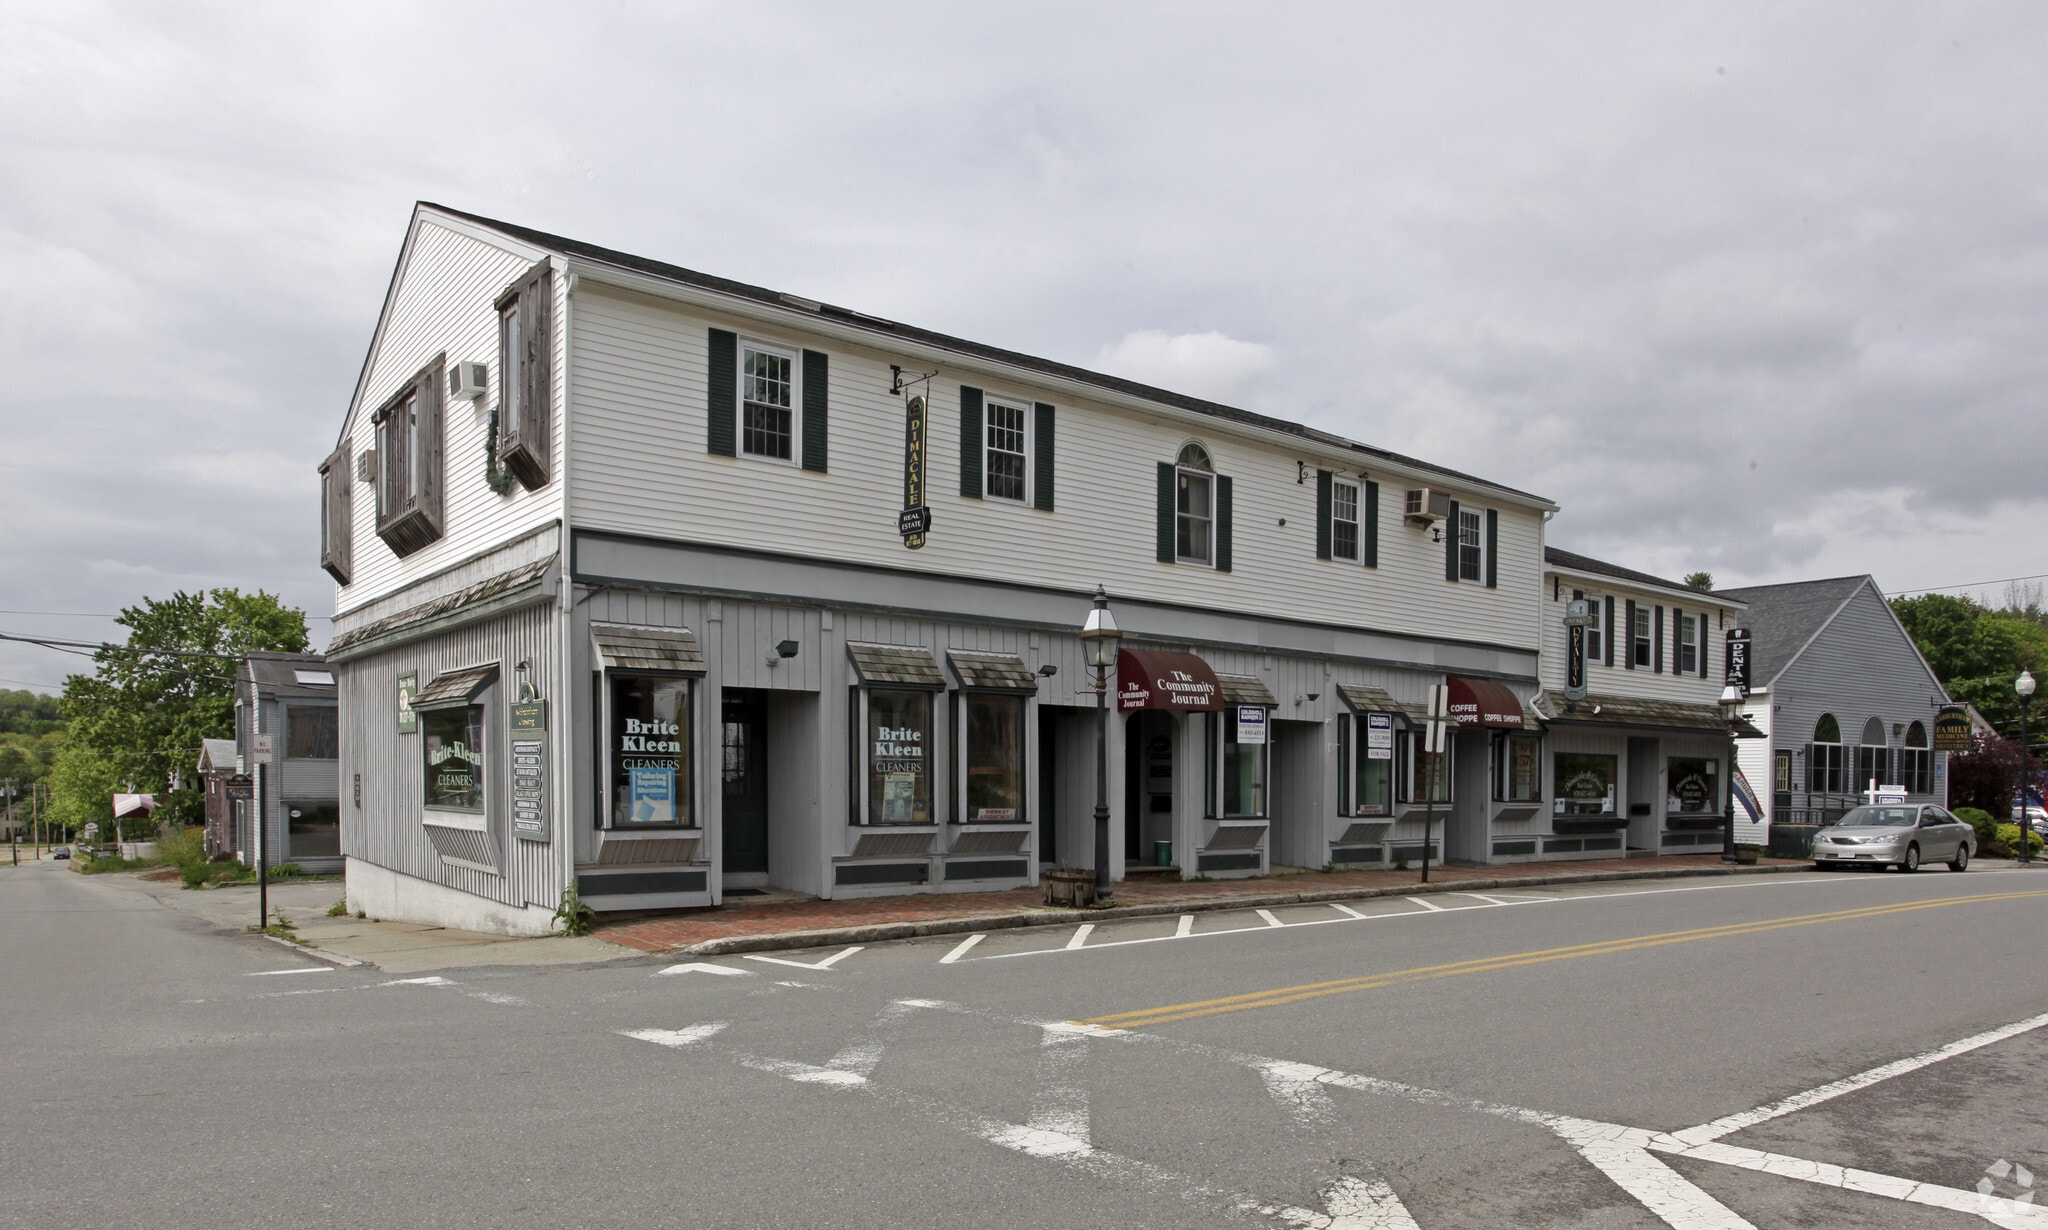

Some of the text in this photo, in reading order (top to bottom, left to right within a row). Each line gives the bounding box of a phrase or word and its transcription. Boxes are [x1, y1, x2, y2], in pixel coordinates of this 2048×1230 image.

[909, 419, 920, 505] DIMACALE
[903, 512, 919, 522] REAL
[902, 520, 921, 530] ESTATE
[1572, 627, 1581, 686] REALTY
[1171, 670, 1193, 682] The
[1128, 682, 1139, 691] The
[1157, 679, 1215, 695] Community
[1118, 689, 1150, 699] Community
[1171, 692, 1209, 705] Journal
[1123, 699, 1145, 707] Journal
[1450, 704, 1477, 712] COFFEE
[1452, 714, 1478, 722] HOPPE
[1484, 713, 1521, 723] COFFEE SHOPPE
[625, 718, 680, 735] Brite
[1936, 726, 1969, 734] FAMILY
[878, 726, 921, 741] Brite
[621, 736, 681, 752] Kleen
[875, 742, 922, 756] Kleen
[431, 740, 482, 766] Brite-Kleen
[622, 759, 680, 770] CLEANERS
[876, 762, 922, 772] CLEANERS
[438, 774, 473, 787] CLEANERS
[637, 772, 667, 780] Tailoring
